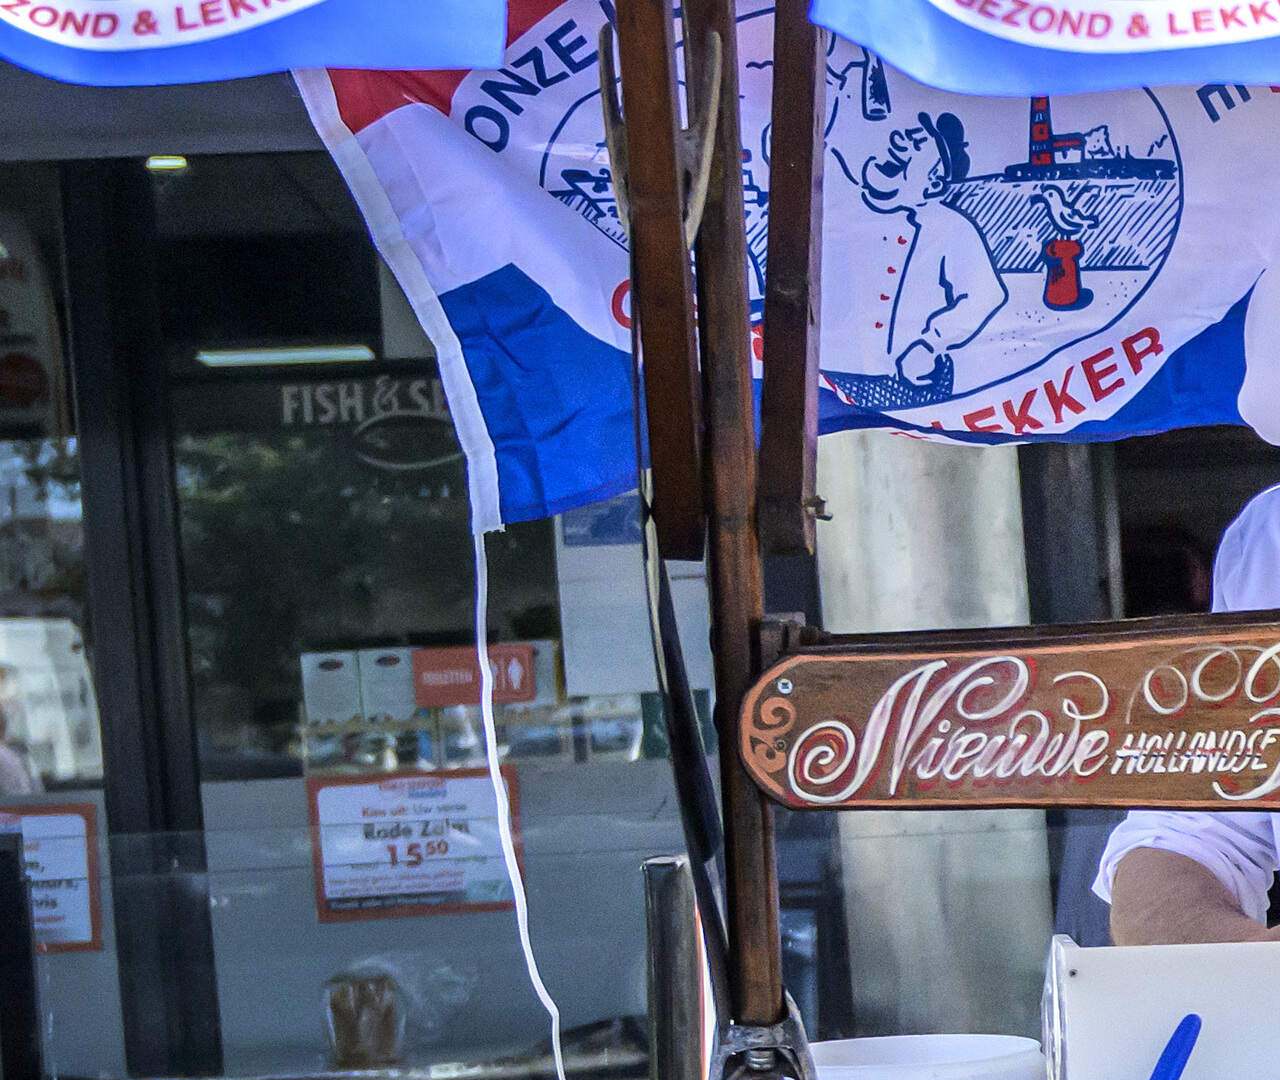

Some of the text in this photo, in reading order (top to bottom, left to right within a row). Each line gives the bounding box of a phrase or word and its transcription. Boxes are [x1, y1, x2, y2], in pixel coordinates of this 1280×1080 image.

[133, 10, 158, 35] &
[1127, 13, 1149, 39] &
[464, 19, 602, 153] ONZE
[281, 383, 364, 424] FISH
[930, 326, 1165, 434] EKKER
[788, 656, 1110, 804] Nieuwe
